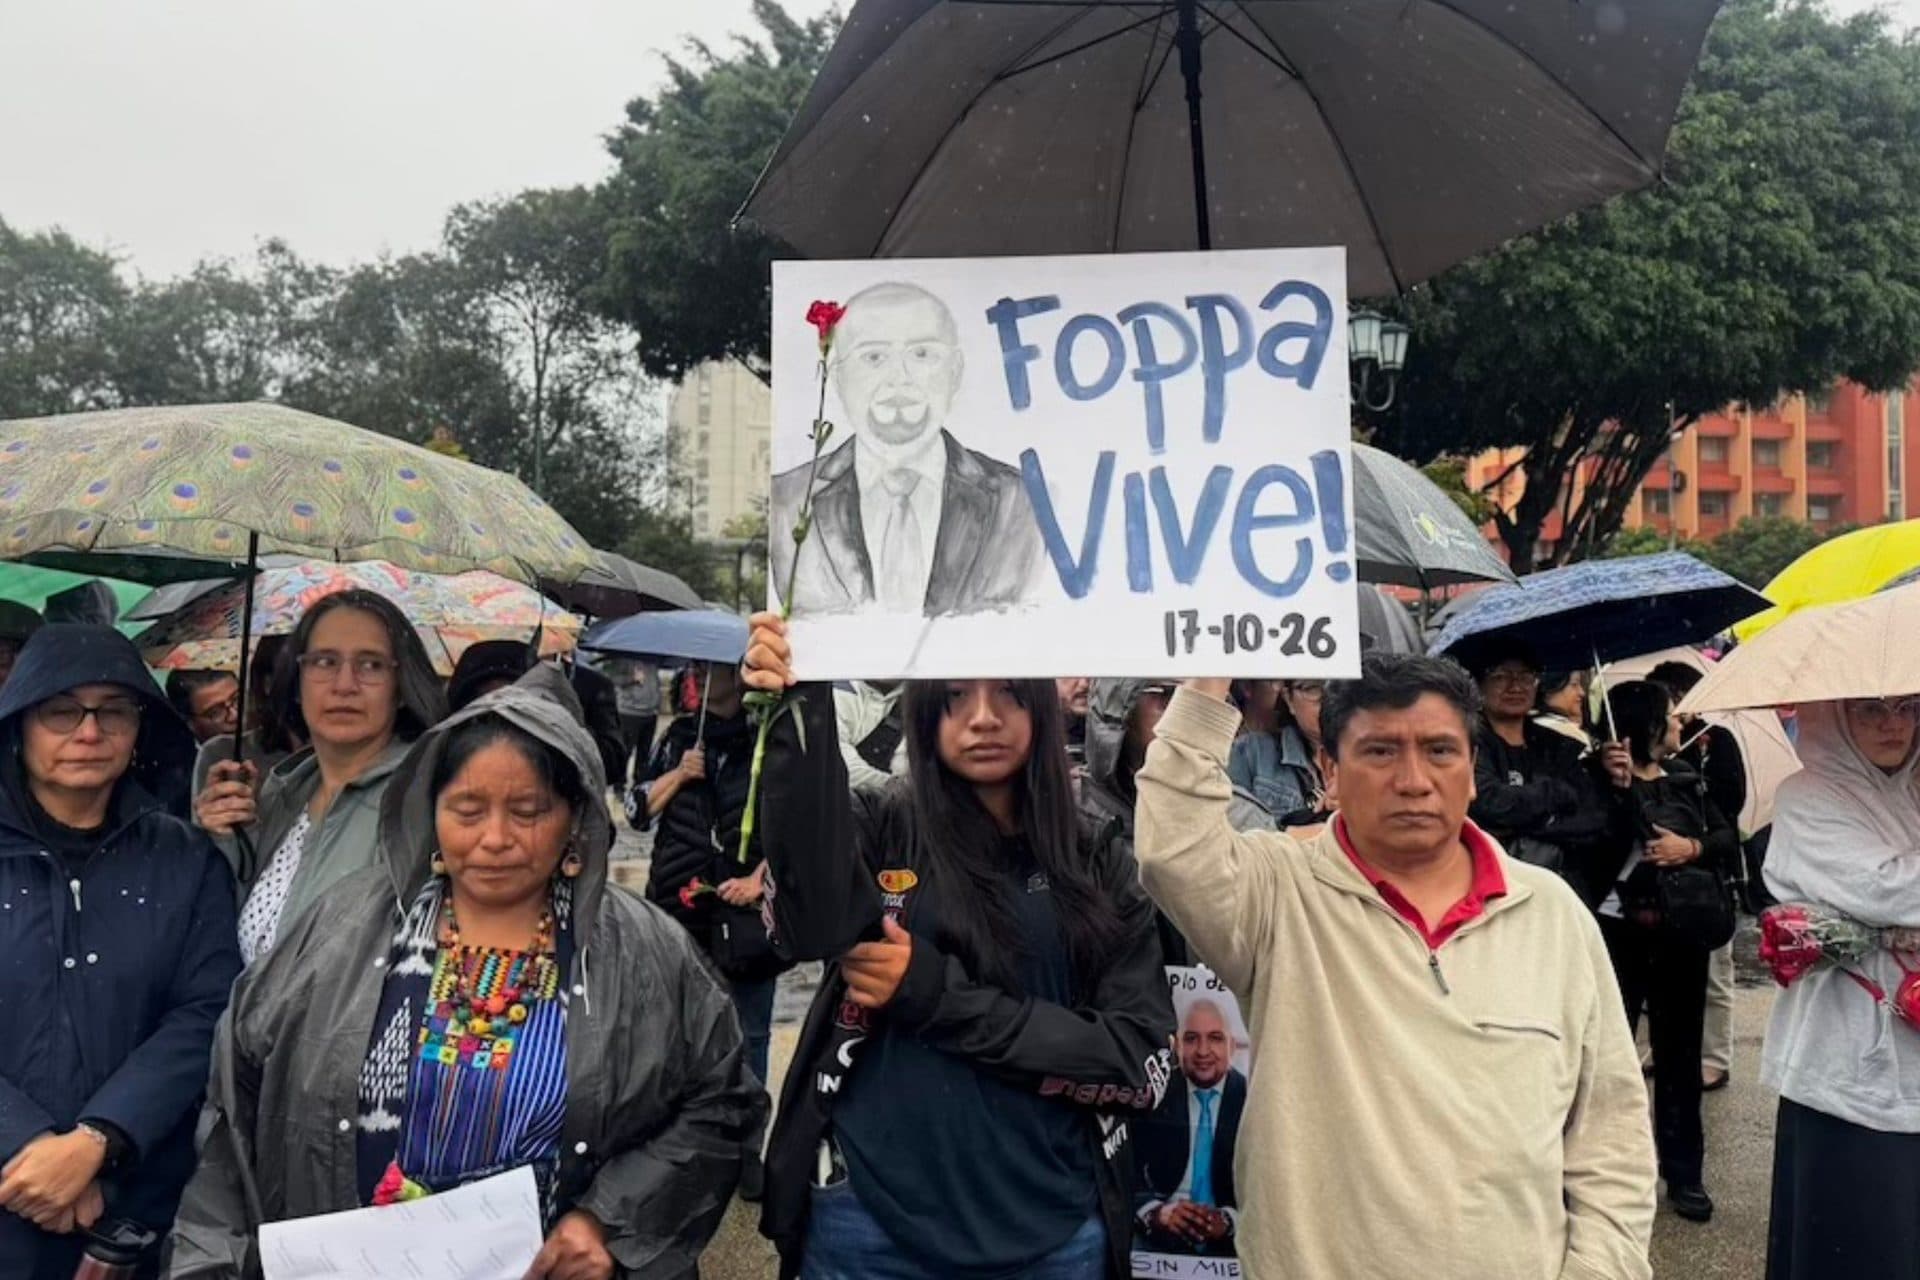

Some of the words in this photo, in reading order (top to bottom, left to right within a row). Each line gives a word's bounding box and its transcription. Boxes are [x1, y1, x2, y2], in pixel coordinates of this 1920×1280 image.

[986, 281, 1334, 454] Foppa
[1164, 609, 1336, 659] 17-10-26
[1131, 1254, 1178, 1274] SIN
